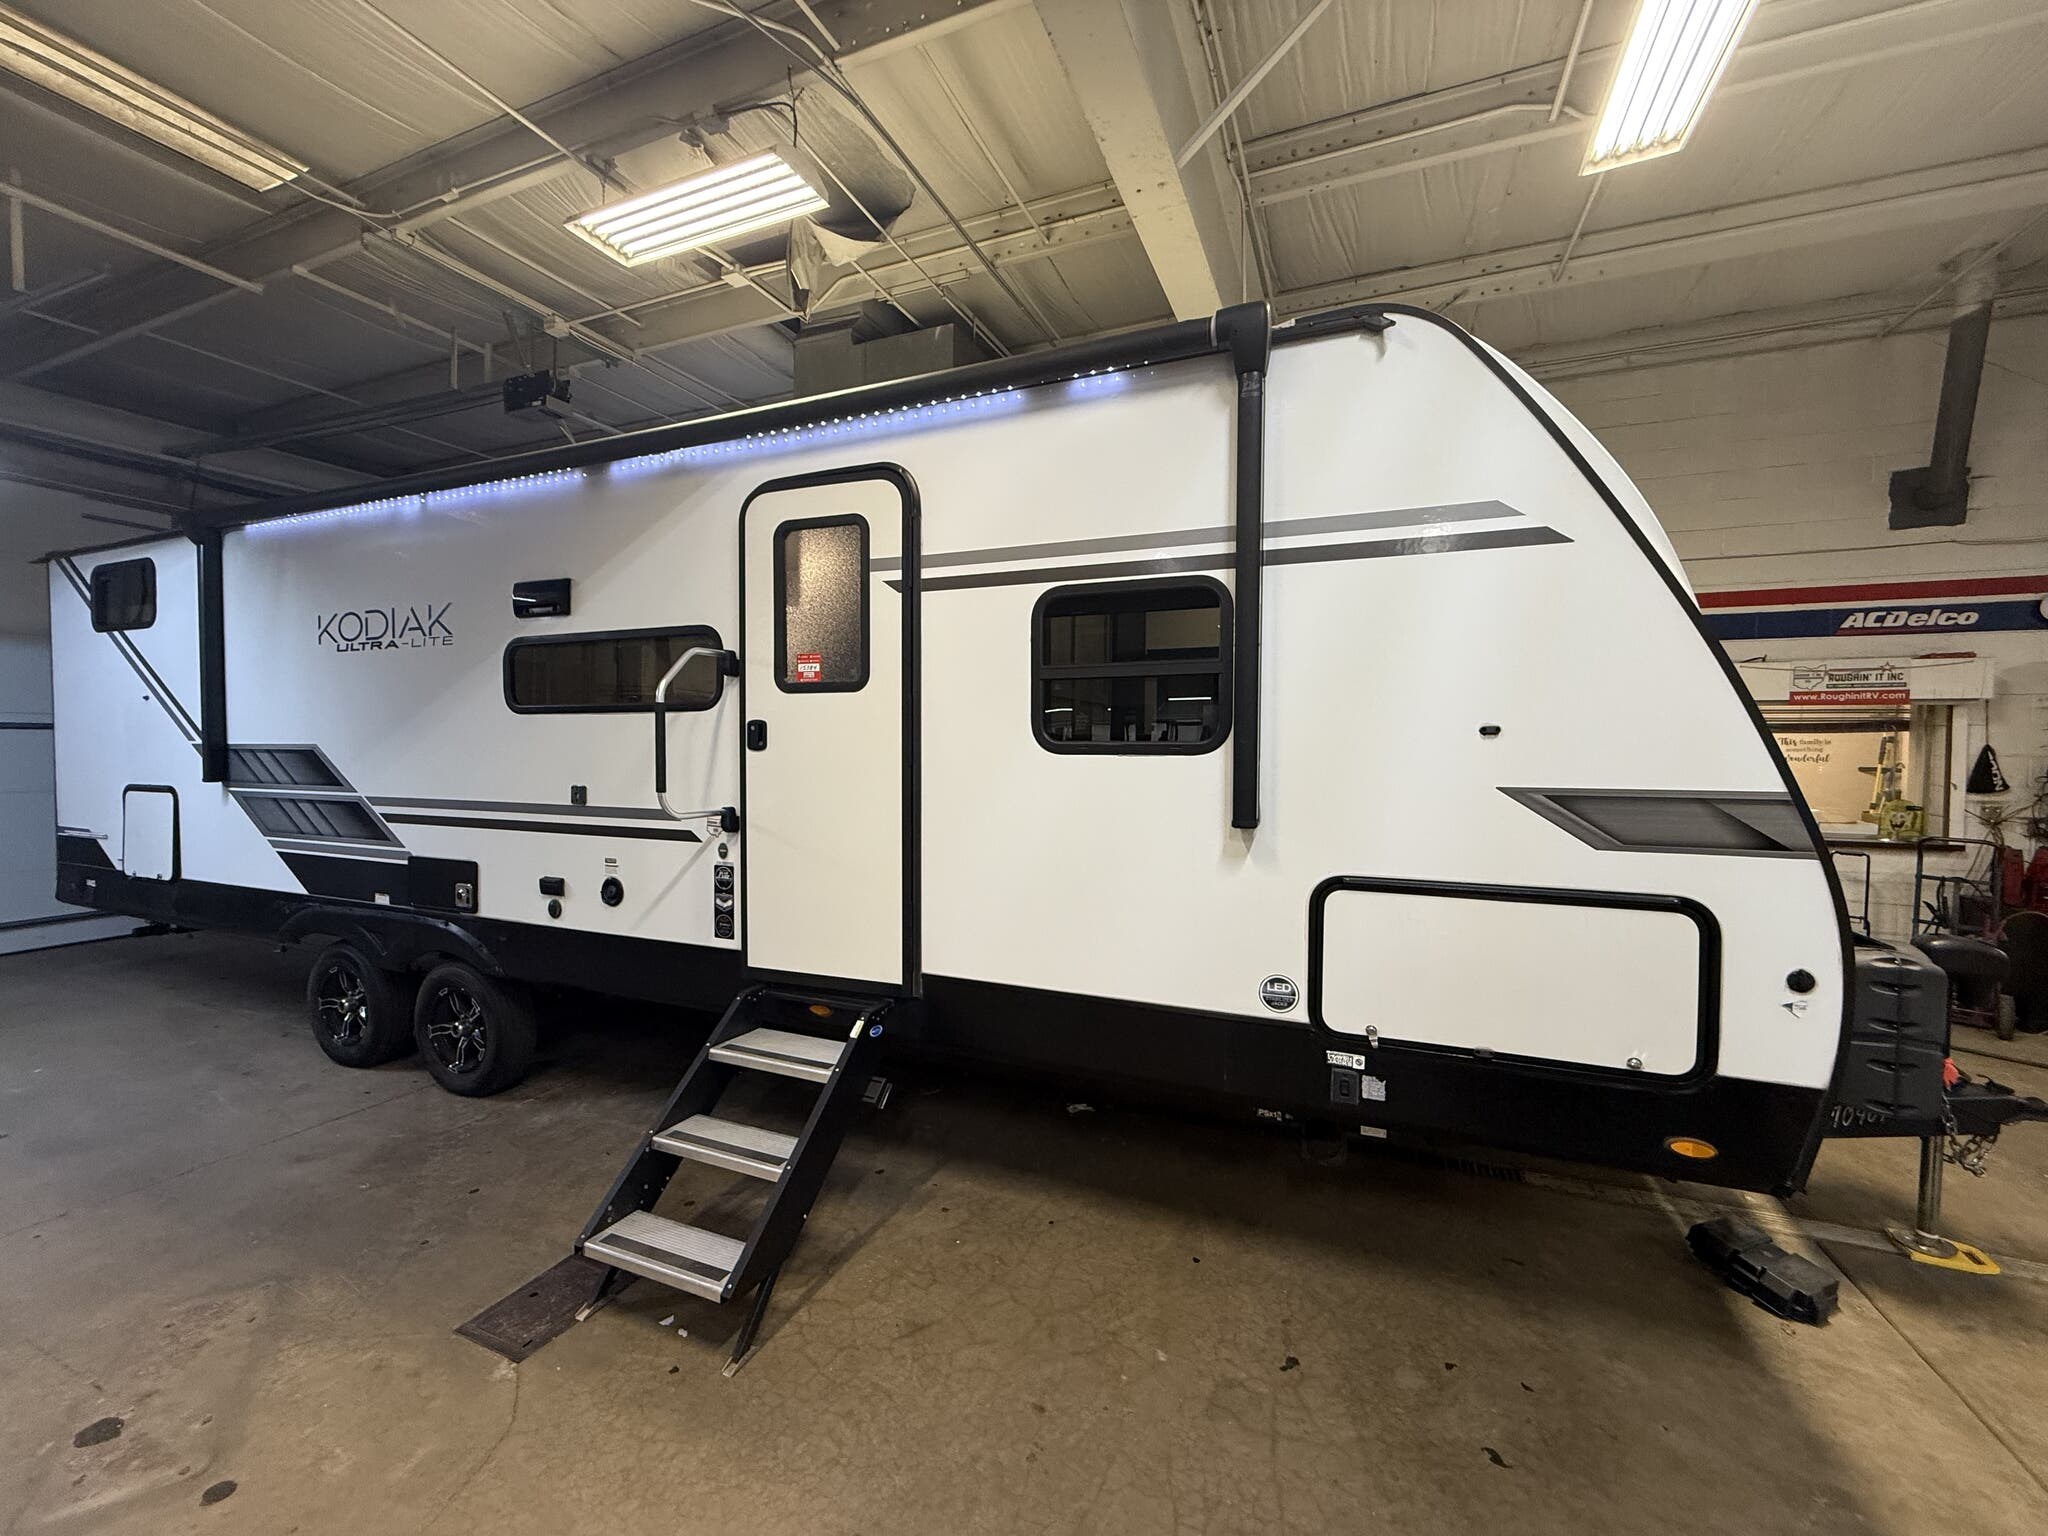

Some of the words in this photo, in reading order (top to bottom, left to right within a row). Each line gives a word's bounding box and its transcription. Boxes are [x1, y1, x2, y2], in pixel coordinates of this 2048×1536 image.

[317, 602, 453, 645] KODIAK
[1840, 608, 1980, 628] ACDelco
[336, 635, 454, 652] ULTRA-LITE
[1875, 673, 1884, 681] IT
[1887, 672, 1904, 681] INC
[1793, 691, 1906, 702] www.RoughinitRV.com
[1778, 737, 1797, 746] This
[1266, 981, 1292, 993] LED
